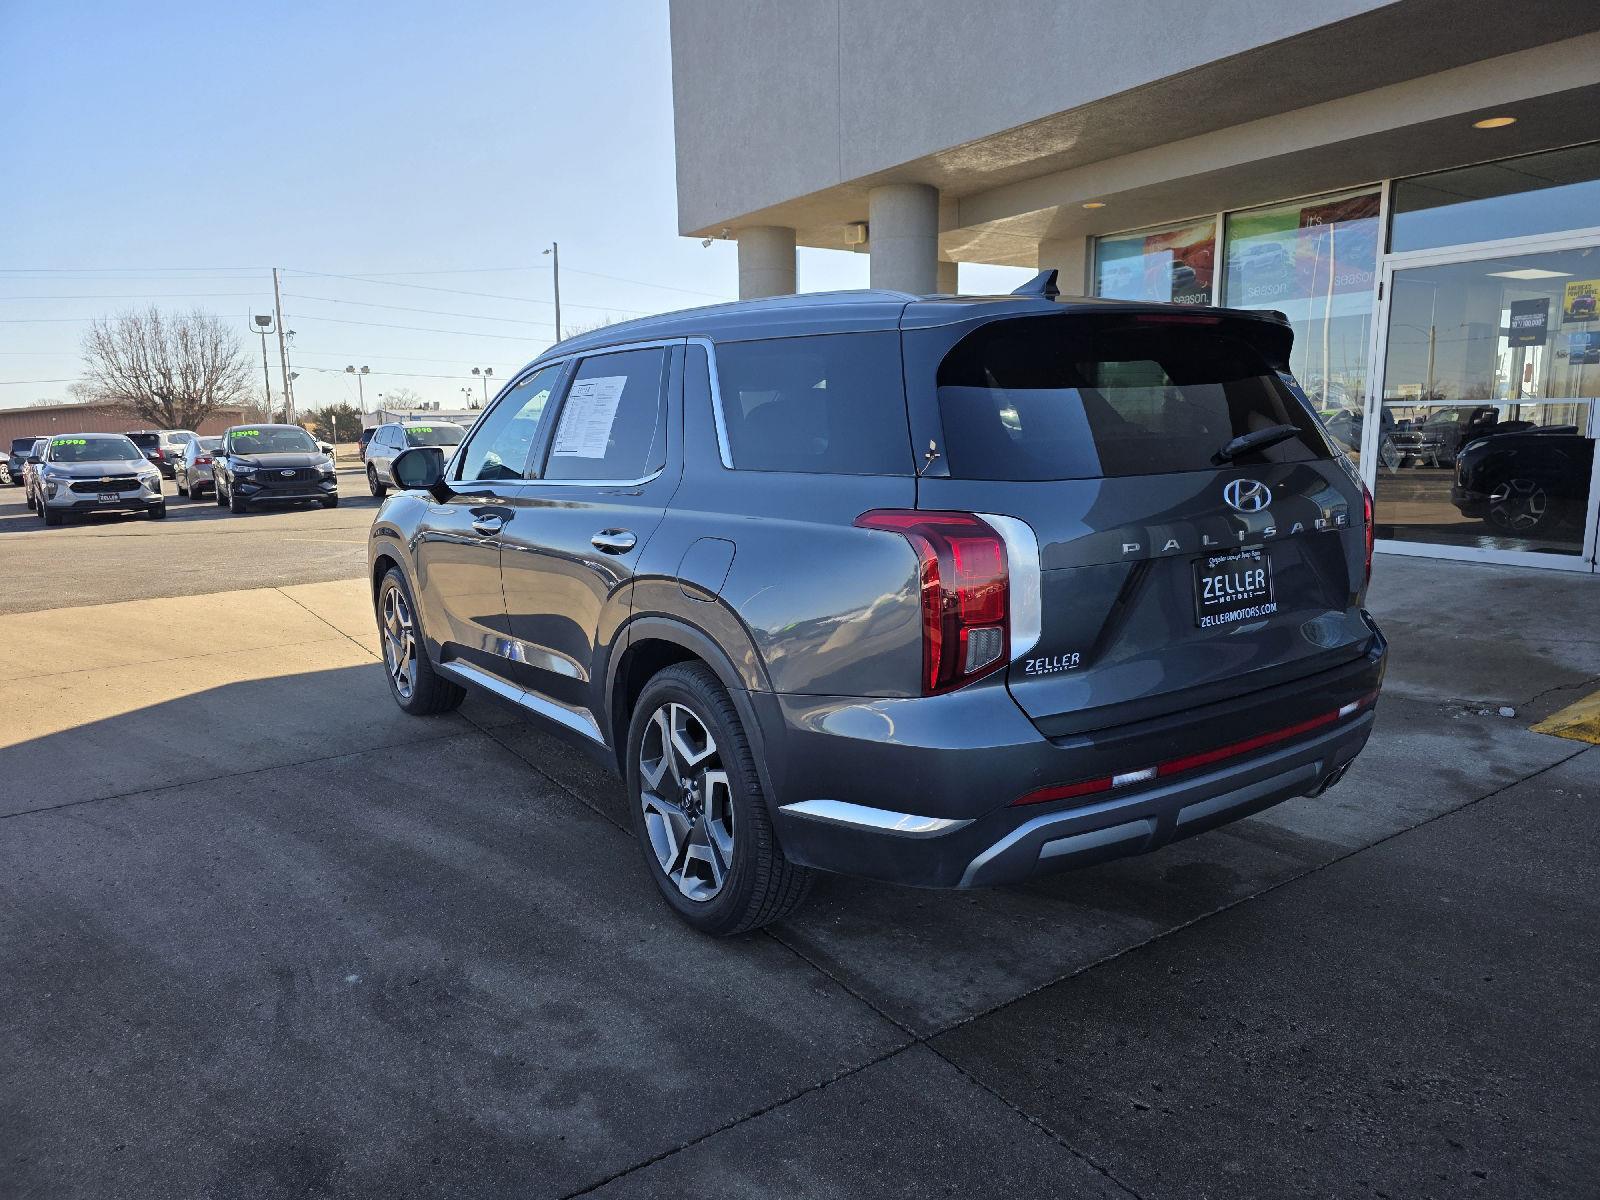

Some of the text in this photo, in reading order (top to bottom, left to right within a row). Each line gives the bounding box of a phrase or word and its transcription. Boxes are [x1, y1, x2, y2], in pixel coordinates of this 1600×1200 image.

[1173, 292, 1209, 305] season.
[1122, 514, 1348, 554] PALISADE
[1202, 568, 1265, 599] ZELLER
[1219, 592, 1253, 603] MOTORS
[1200, 602, 1278, 628] ZELLERMOTORS.COM
[1025, 652, 1080, 672] ZELLER
